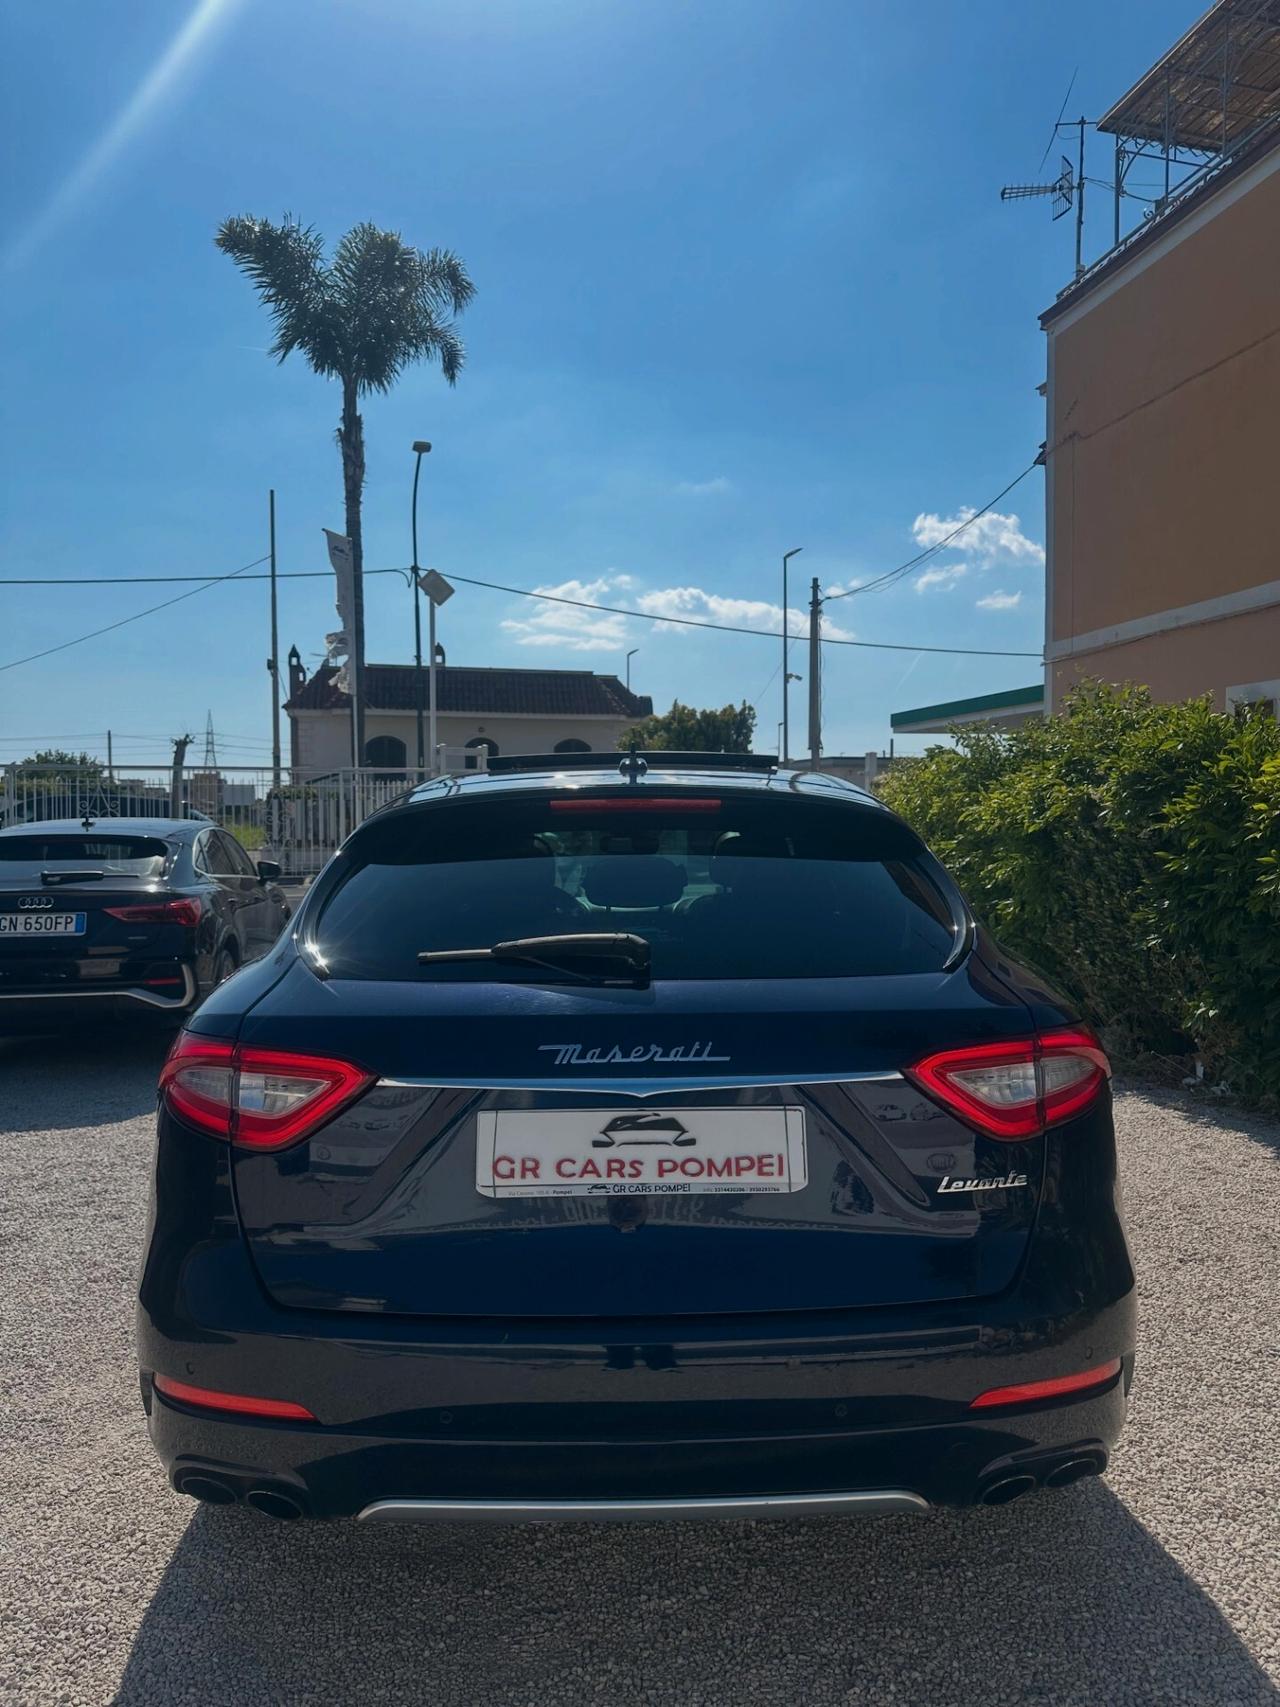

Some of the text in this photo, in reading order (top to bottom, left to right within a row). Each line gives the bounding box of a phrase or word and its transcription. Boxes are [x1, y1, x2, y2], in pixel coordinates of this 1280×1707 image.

[0, 915, 74, 932] GN 650FP
[537, 1041, 731, 1065] Maserati
[492, 1153, 785, 1180] GR CARS POMPEI
[612, 1183, 691, 1194] GR CARS POMPEI
[937, 1170, 1028, 1194] Levante
